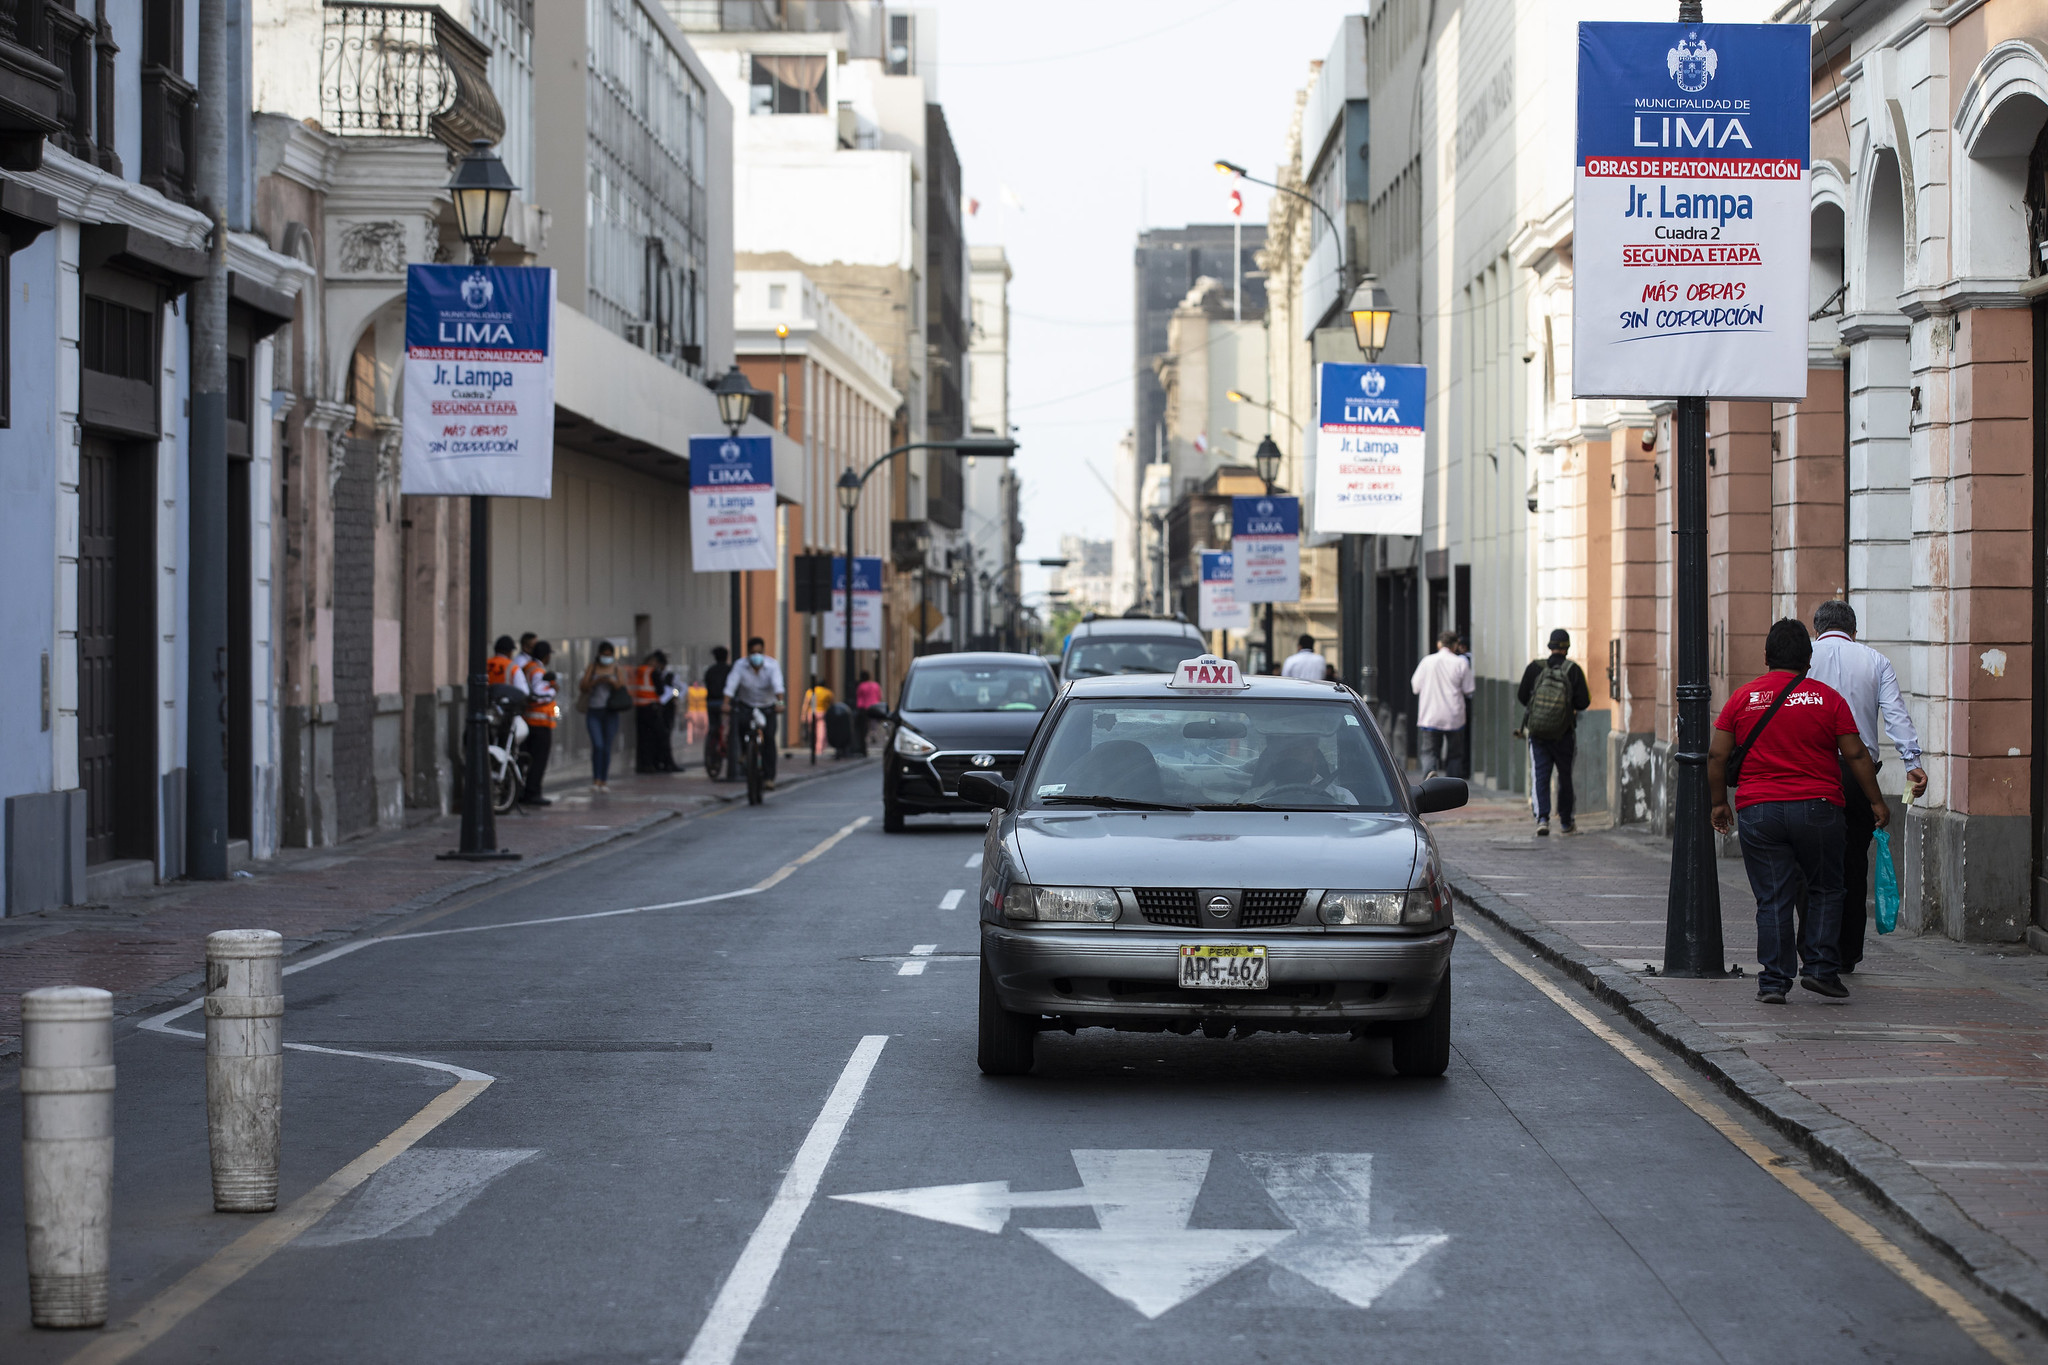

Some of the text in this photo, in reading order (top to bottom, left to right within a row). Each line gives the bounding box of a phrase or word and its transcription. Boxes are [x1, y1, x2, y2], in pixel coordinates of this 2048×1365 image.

[1634, 98, 1750, 110] MUNICIPALIDAD DE
[1634, 116, 1752, 148] LIMA
[1588, 160, 1798, 178] OBRAS DE PEATONALIZACIÓN
[1625, 184, 1753, 227] Jr. Lampa
[1655, 226, 1720, 240] Cuadra 2
[1623, 248, 1760, 263] SEGUNDA ETAPA
[1642, 280, 1746, 302] MÁS OBRAS
[440, 311, 512, 320] MUNICIPALIDAD DE
[1620, 304, 1764, 329] SIN CORRUPCIÓN
[439, 322, 514, 344] LIMA
[411, 348, 543, 362] OBRAS DE PEATONALIZACIÓN
[433, 364, 513, 391] Jr. Lampa
[452, 390, 493, 399] Cuadra 2
[432, 402, 517, 413] SEGUNDA ETAPA
[1344, 405, 1400, 423] LIMA
[1341, 437, 1399, 456] Jr. Lampa
[708, 469, 754, 484] LIMA
[1247, 522, 1283, 533] LIMA
[1184, 666, 1233, 684] TAXI
[1784, 697, 1823, 706] JOVEN
[1208, 948, 1239, 956] PERU
[1183, 957, 1264, 981] APG-467
